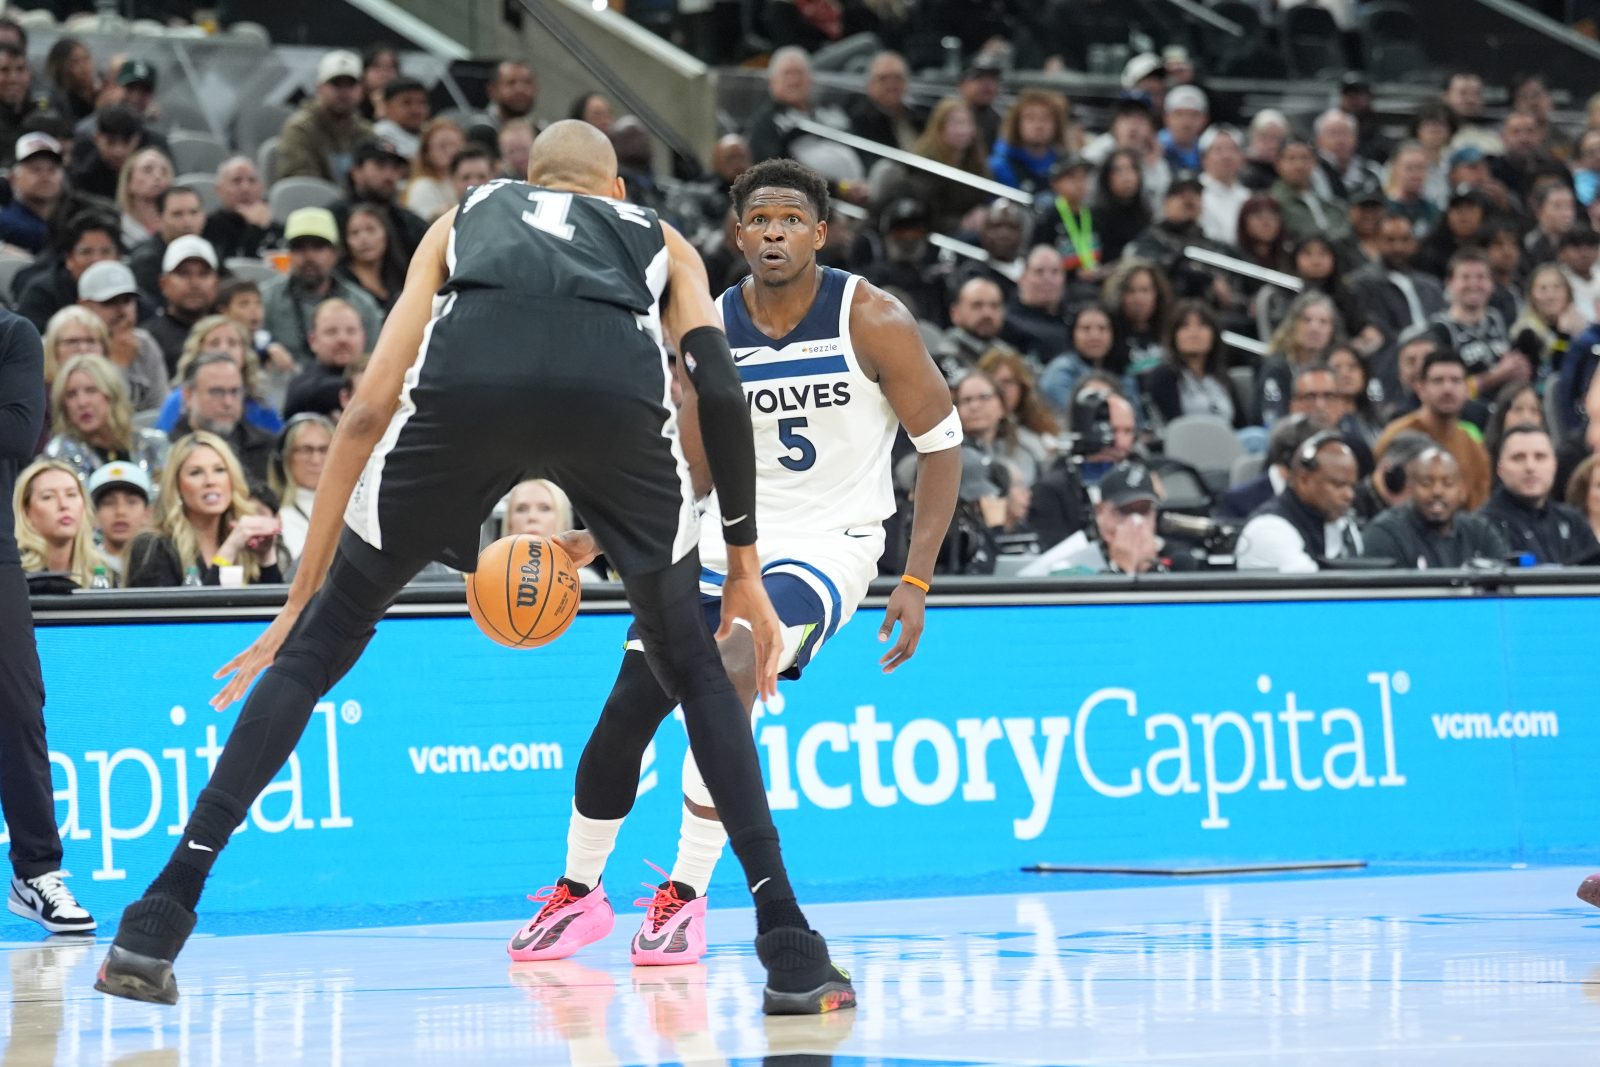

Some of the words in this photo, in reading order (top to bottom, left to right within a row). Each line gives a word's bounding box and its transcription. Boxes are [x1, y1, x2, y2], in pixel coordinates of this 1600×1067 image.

[521, 191, 575, 241] 1
[809, 343, 838, 354] sezzle
[747, 381, 852, 414] OLVES
[777, 416, 817, 472] 5
[516, 540, 543, 608] Wilson
[1432, 711, 1559, 740] vcm.com
[0, 701, 354, 882] apital
[409, 742, 563, 774] vcm.com
